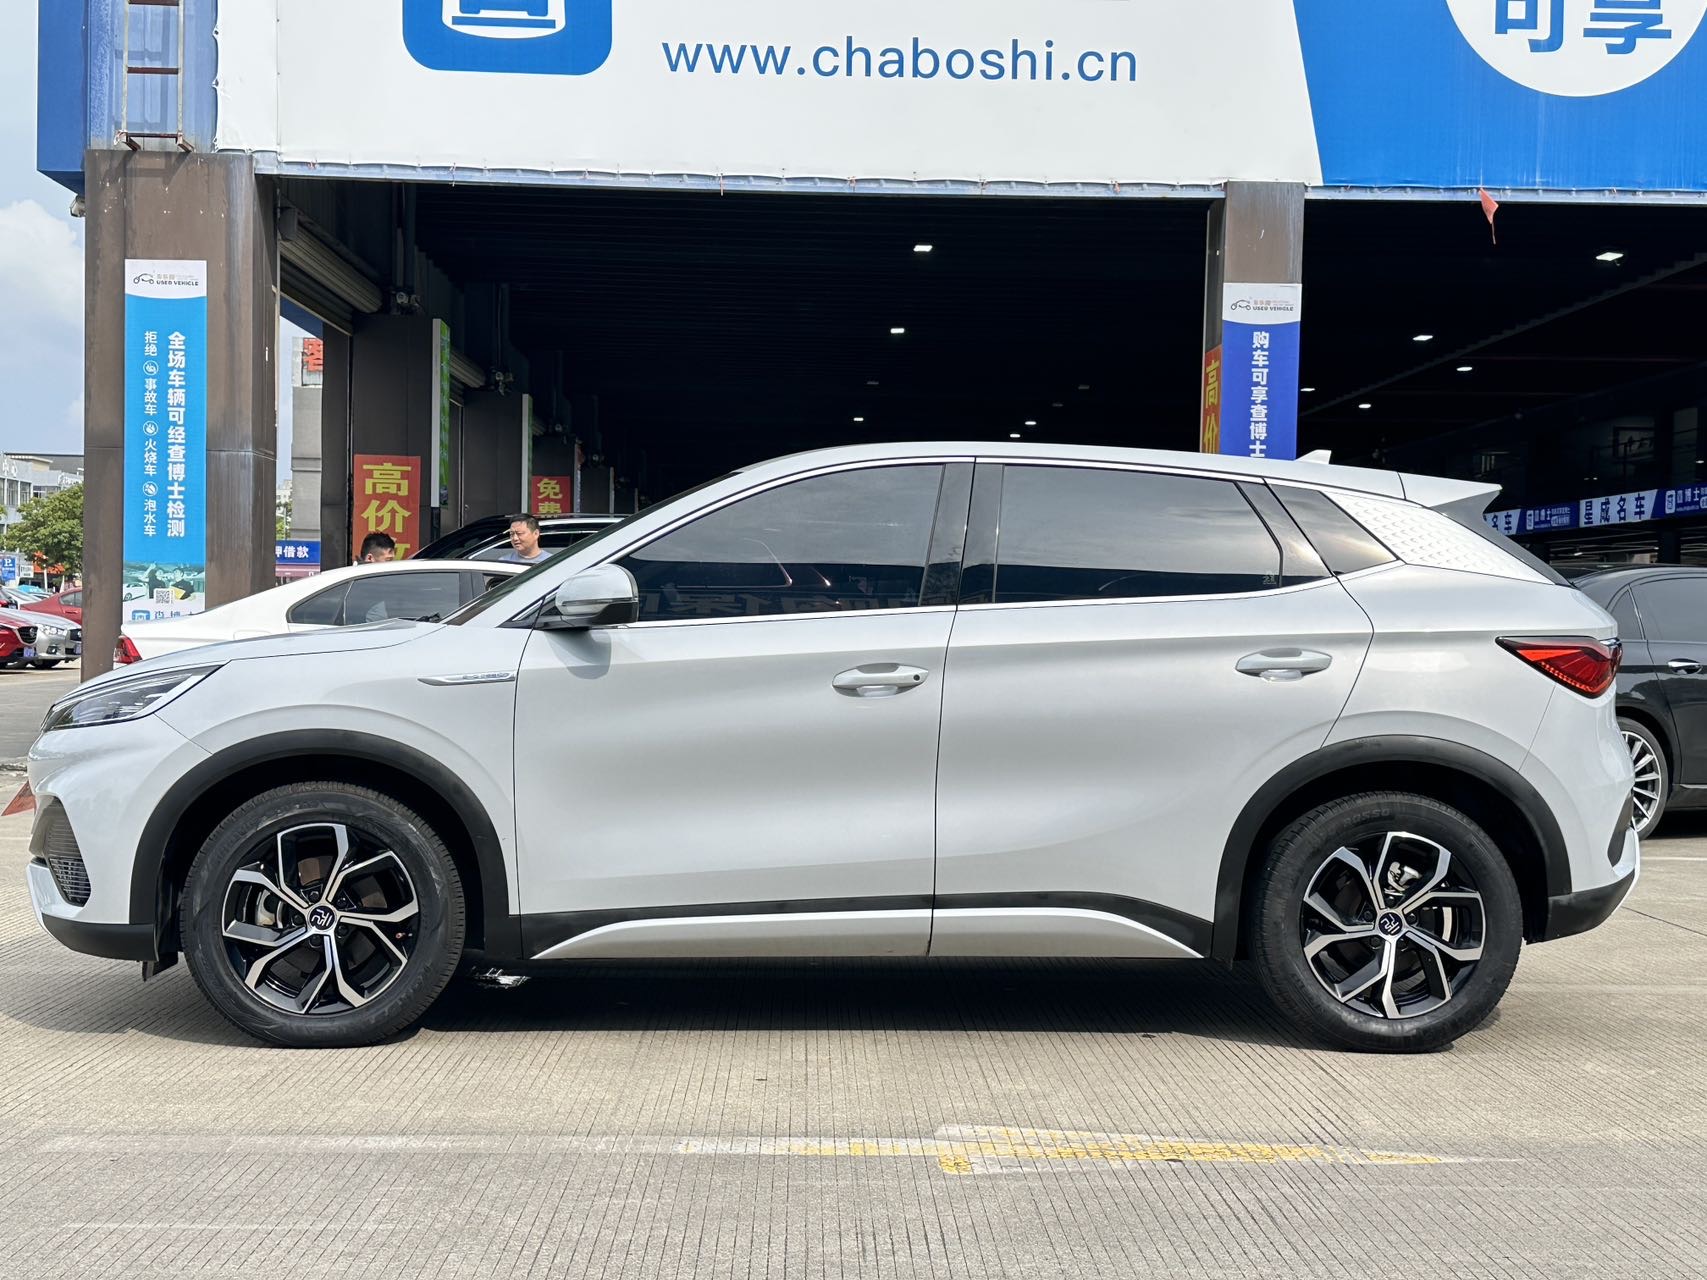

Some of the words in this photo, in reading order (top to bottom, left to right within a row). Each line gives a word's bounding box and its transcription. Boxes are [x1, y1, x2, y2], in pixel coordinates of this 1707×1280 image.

[1495, 0, 1672, 54] 可享
[662, 36, 1138, 82] www.chaboshi.cn
[144, 331, 158, 356] 拒绝
[144, 378, 158, 416] 事故车
[1249, 331, 1270, 458] 购车可享查博士
[167, 331, 186, 538] 全场车辆可经查博士检测
[143, 438, 157, 476] 火烧车
[143, 499, 157, 537] 泡水车
